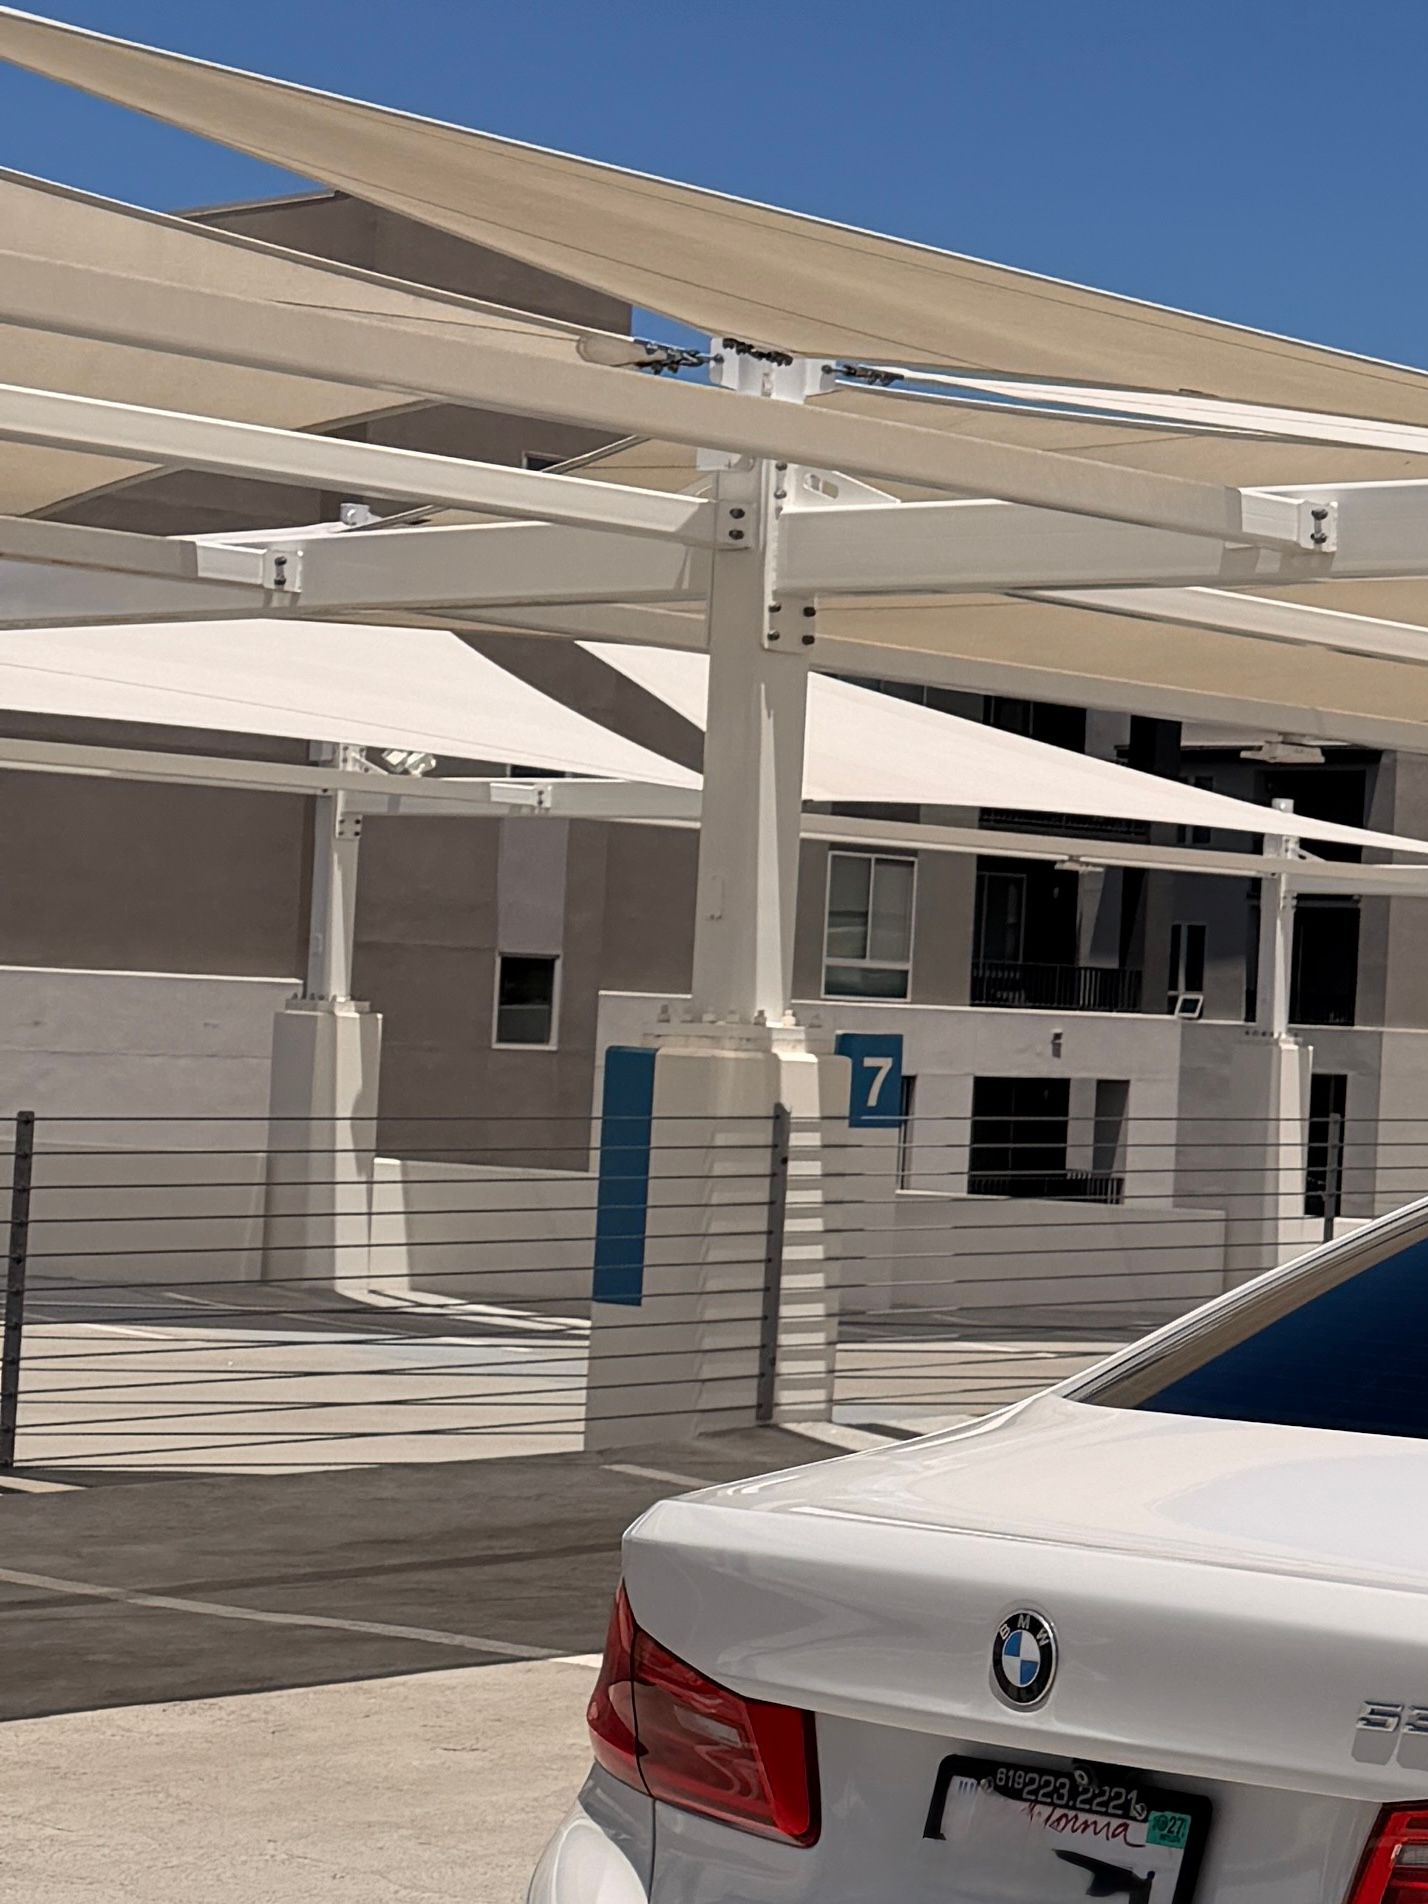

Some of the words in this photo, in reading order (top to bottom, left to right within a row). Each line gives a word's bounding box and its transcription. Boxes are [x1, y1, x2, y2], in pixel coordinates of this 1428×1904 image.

[863, 1057, 893, 1107] 7
[1000, 1614, 1050, 1647] BMW
[1167, 1815, 1186, 1834] 27
